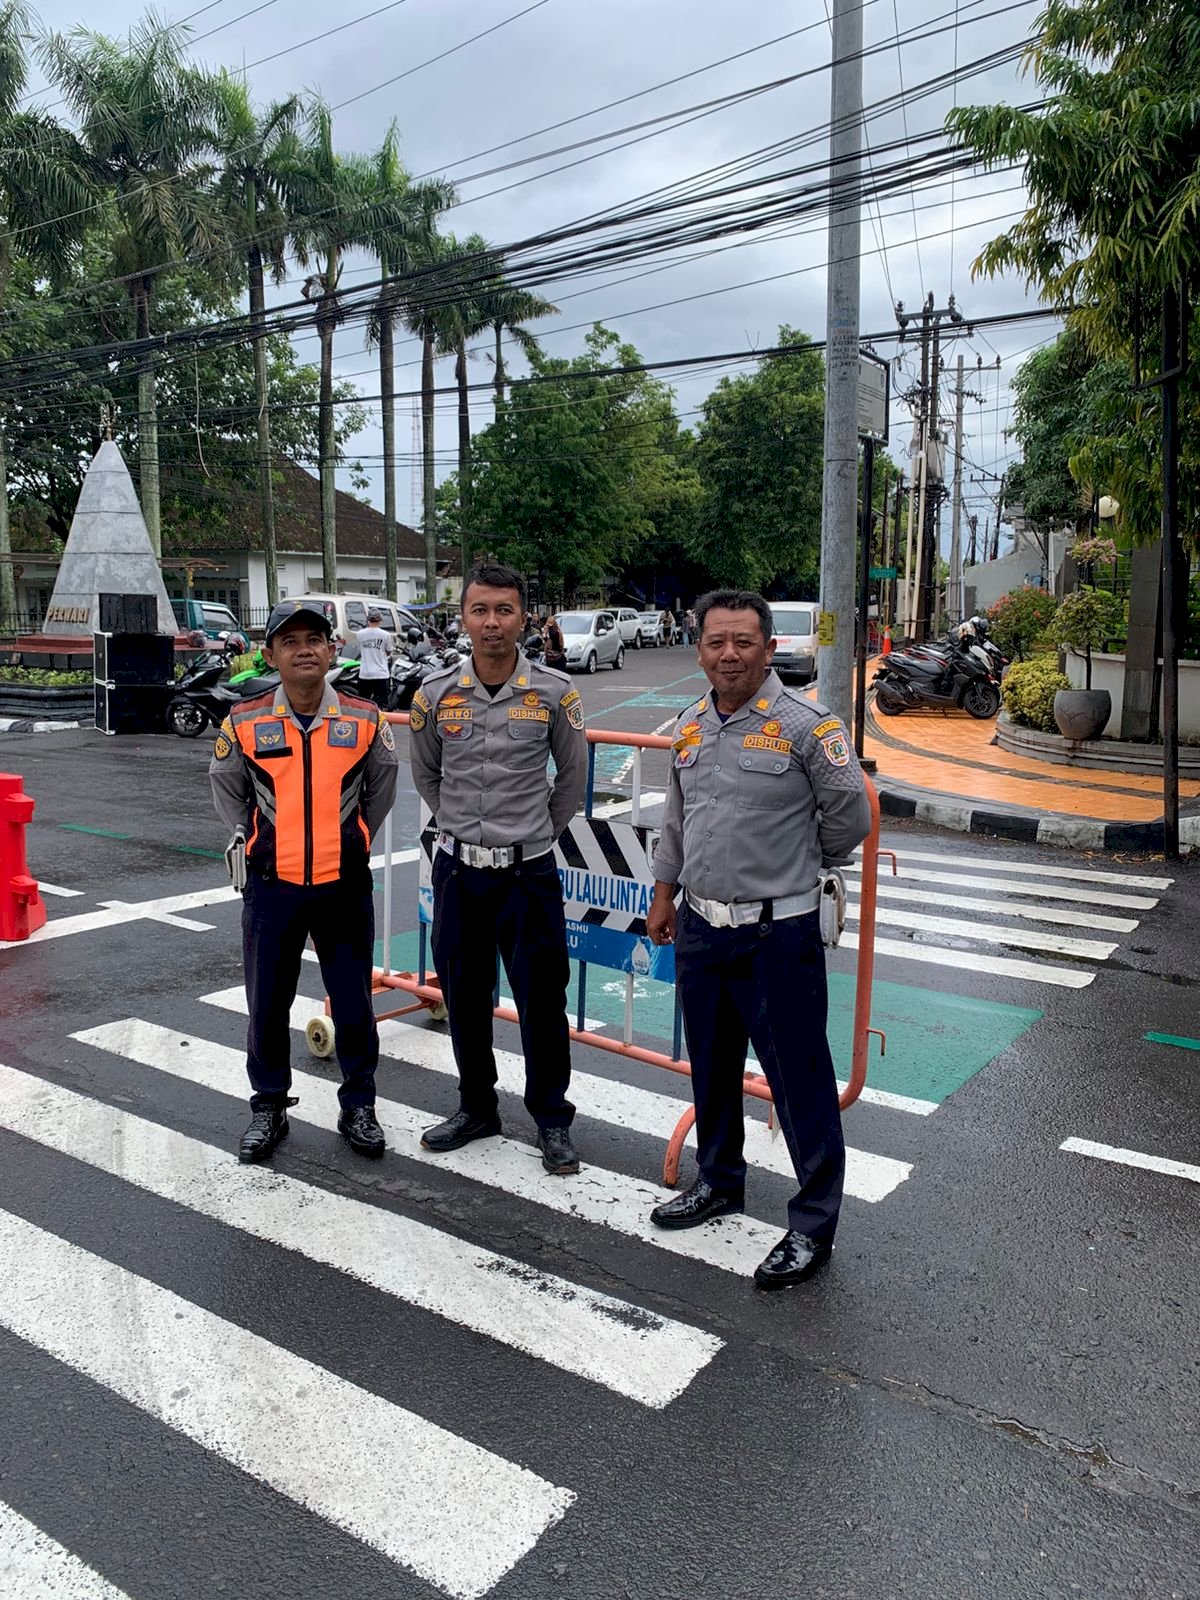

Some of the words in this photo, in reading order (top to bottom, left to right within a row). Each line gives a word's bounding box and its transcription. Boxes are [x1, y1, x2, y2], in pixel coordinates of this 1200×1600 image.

[48, 607, 89, 623] PERWARI
[511, 708, 547, 719] DISHUB
[746, 736, 790, 752] DISHUB
[576, 871, 608, 907] LALU
